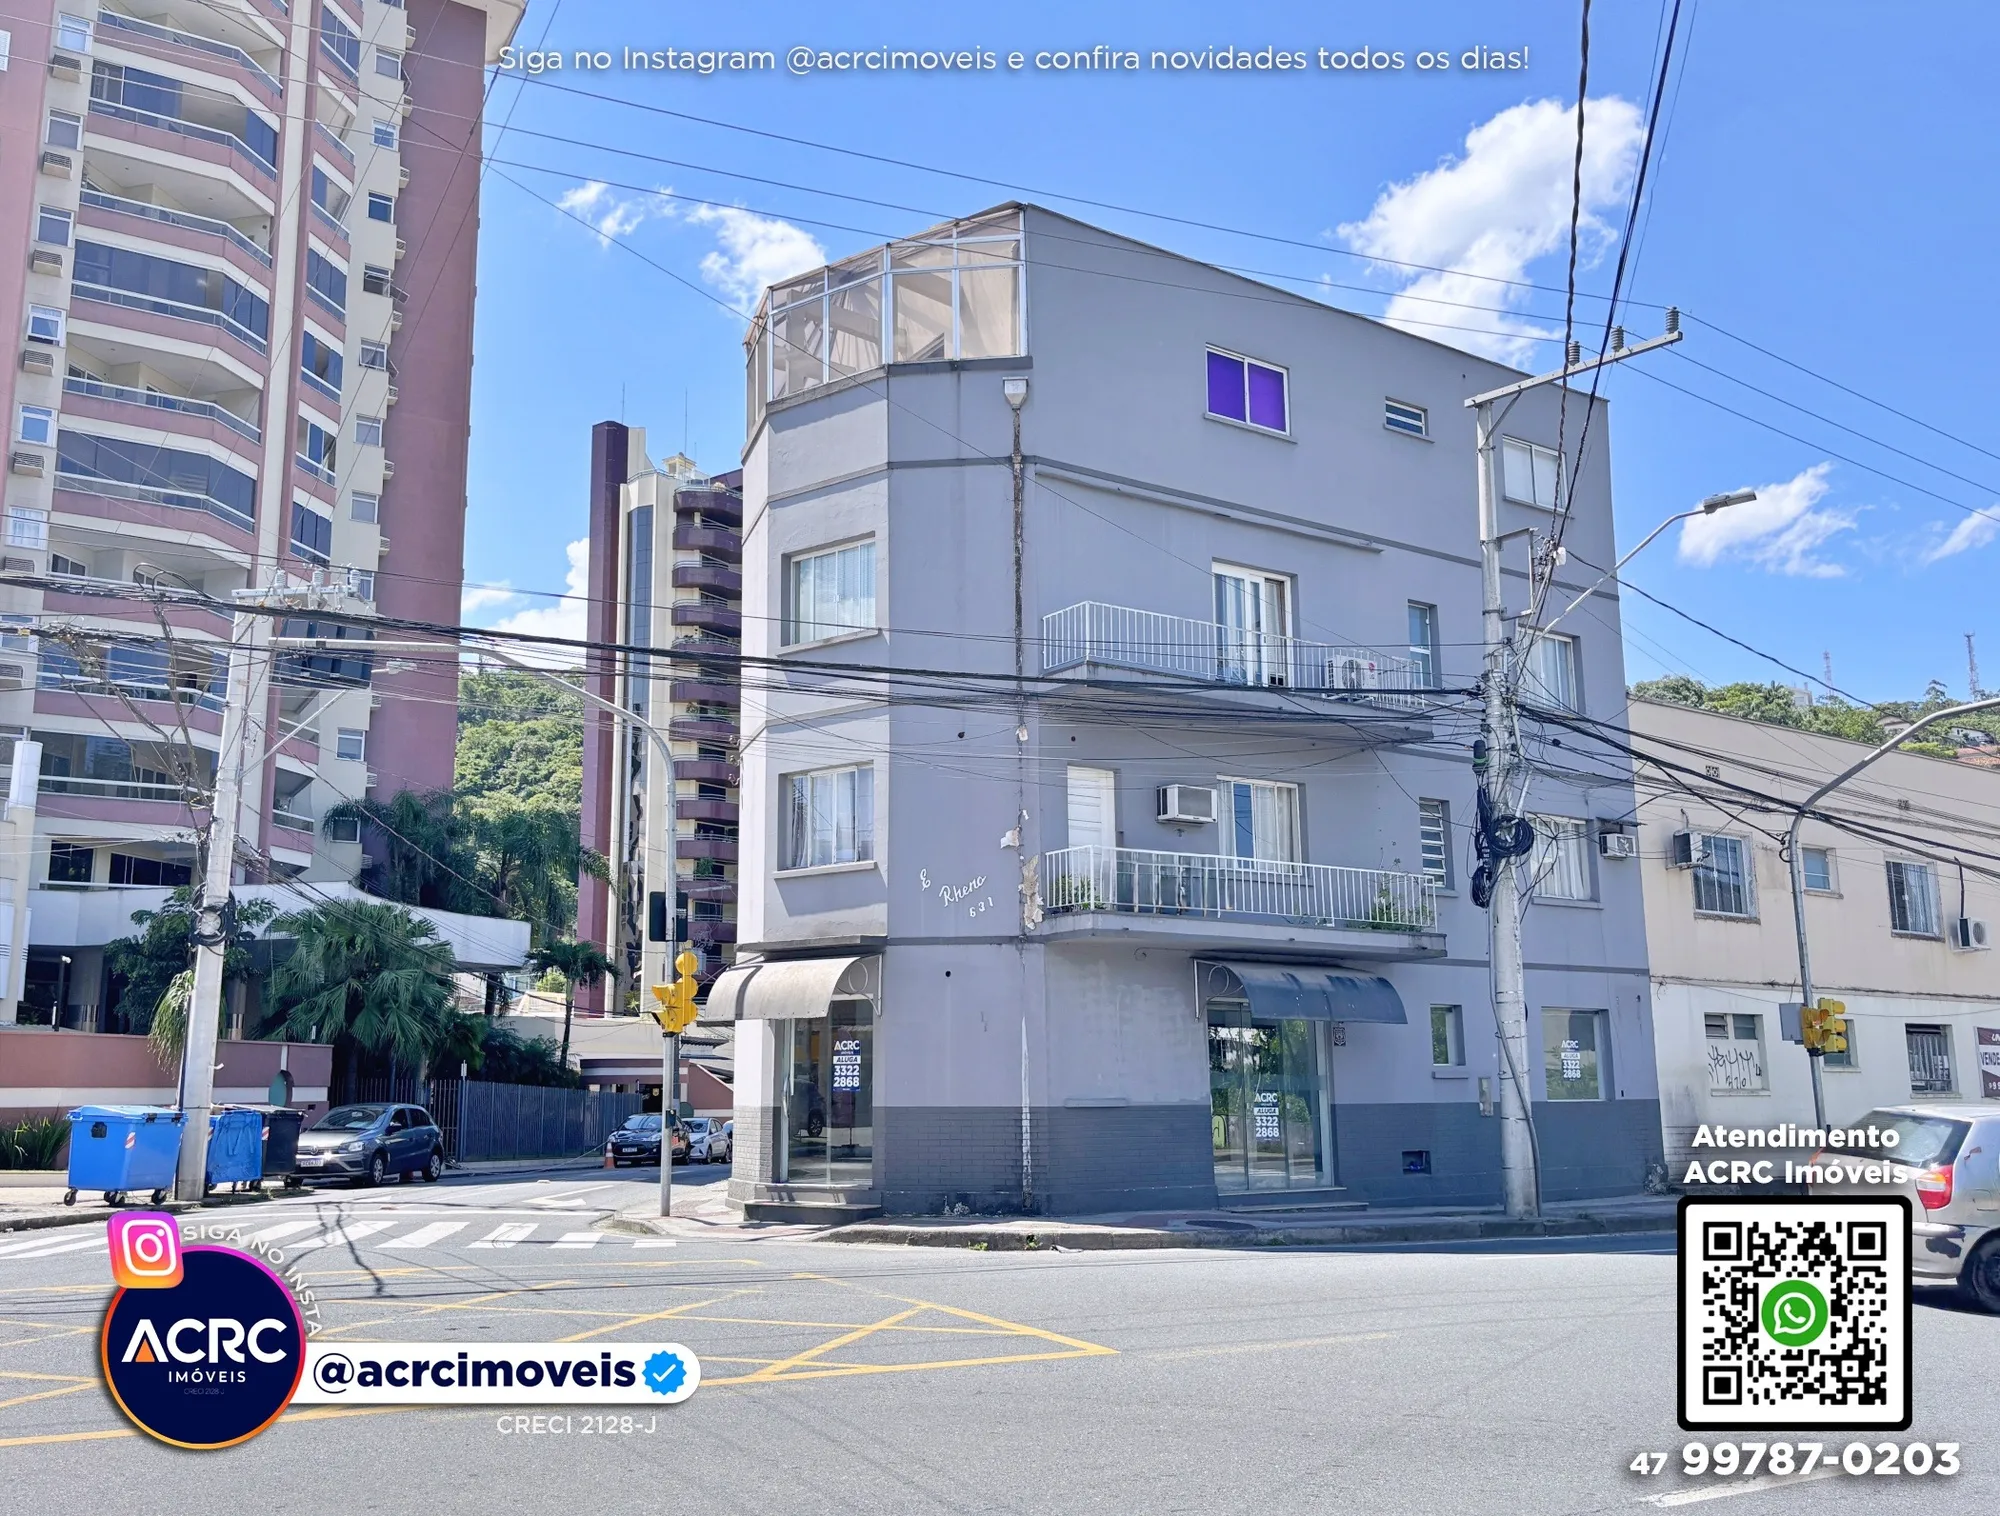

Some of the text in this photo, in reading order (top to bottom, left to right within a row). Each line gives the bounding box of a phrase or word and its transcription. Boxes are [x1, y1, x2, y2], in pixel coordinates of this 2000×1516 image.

[969, 896, 994, 918] 631
[834, 1040, 860, 1051] ACRC
[1561, 1040, 1579, 1048] ACRC
[834, 1065, 860, 1076] 3322
[833, 1076, 860, 1087] 2868
[1254, 1093, 1278, 1102] ACRC
[1255, 1116, 1279, 1126] 3322
[1255, 1127, 1280, 1138] 2868
